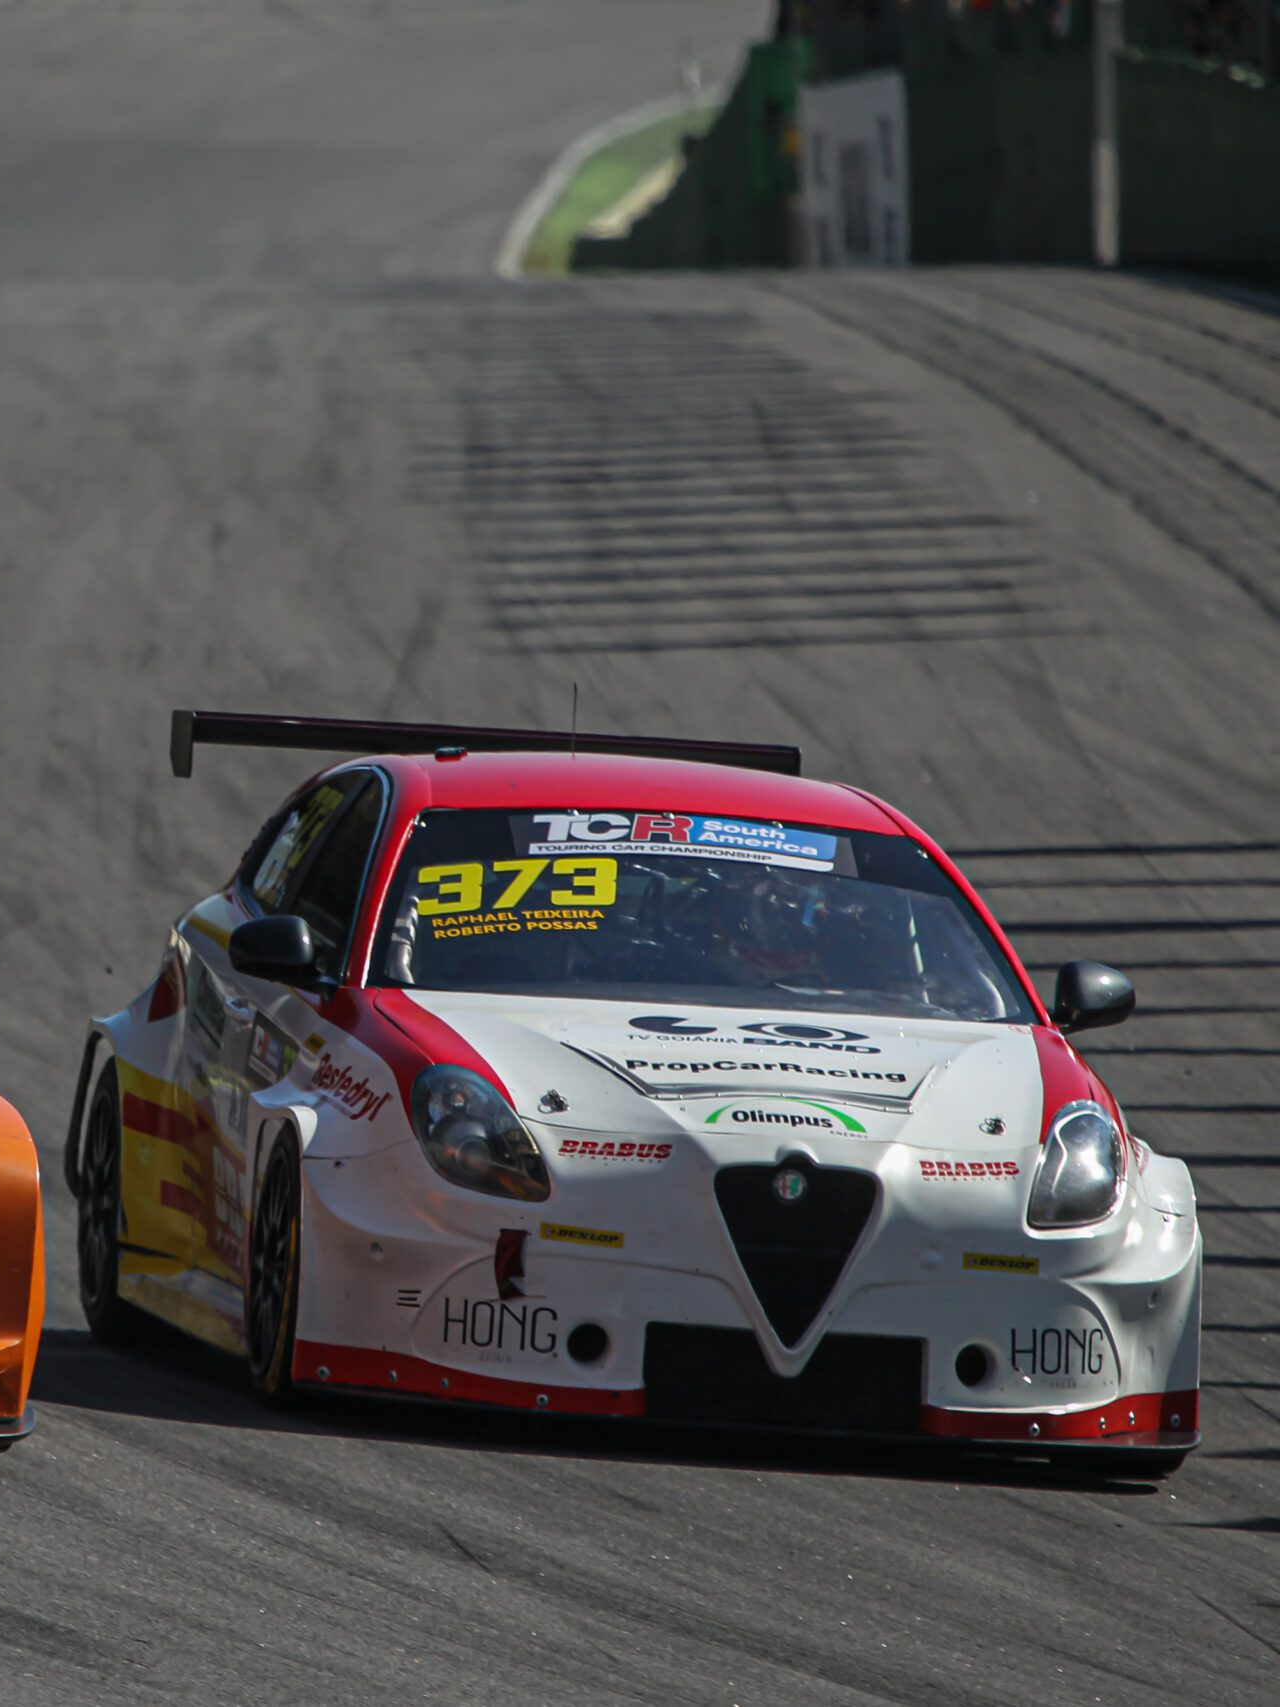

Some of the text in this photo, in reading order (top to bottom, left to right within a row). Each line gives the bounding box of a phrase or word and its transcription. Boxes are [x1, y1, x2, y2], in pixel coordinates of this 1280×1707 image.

[532, 813, 694, 842] TCR
[702, 820, 787, 840] South
[537, 844, 773, 861] TOURING CAR CHAMPIONSHIP
[698, 831, 818, 857] America
[417, 857, 618, 916] 373
[431, 909, 606, 928] RAPHAEL TEIXEIRA
[433, 920, 599, 940] ROBERTO POSSAS
[742, 1037, 882, 1055] BAND
[625, 1058, 908, 1083] PropCarRacing
[731, 1109, 834, 1129] Olimpus
[558, 1139, 673, 1160] BRABUS
[919, 1160, 1020, 1177] BRABUS
[556, 1228, 620, 1244] DUNLOP
[978, 1257, 1036, 1270] DUNLOP
[443, 1296, 558, 1354] HONG
[1010, 1327, 1104, 1375] HONG
